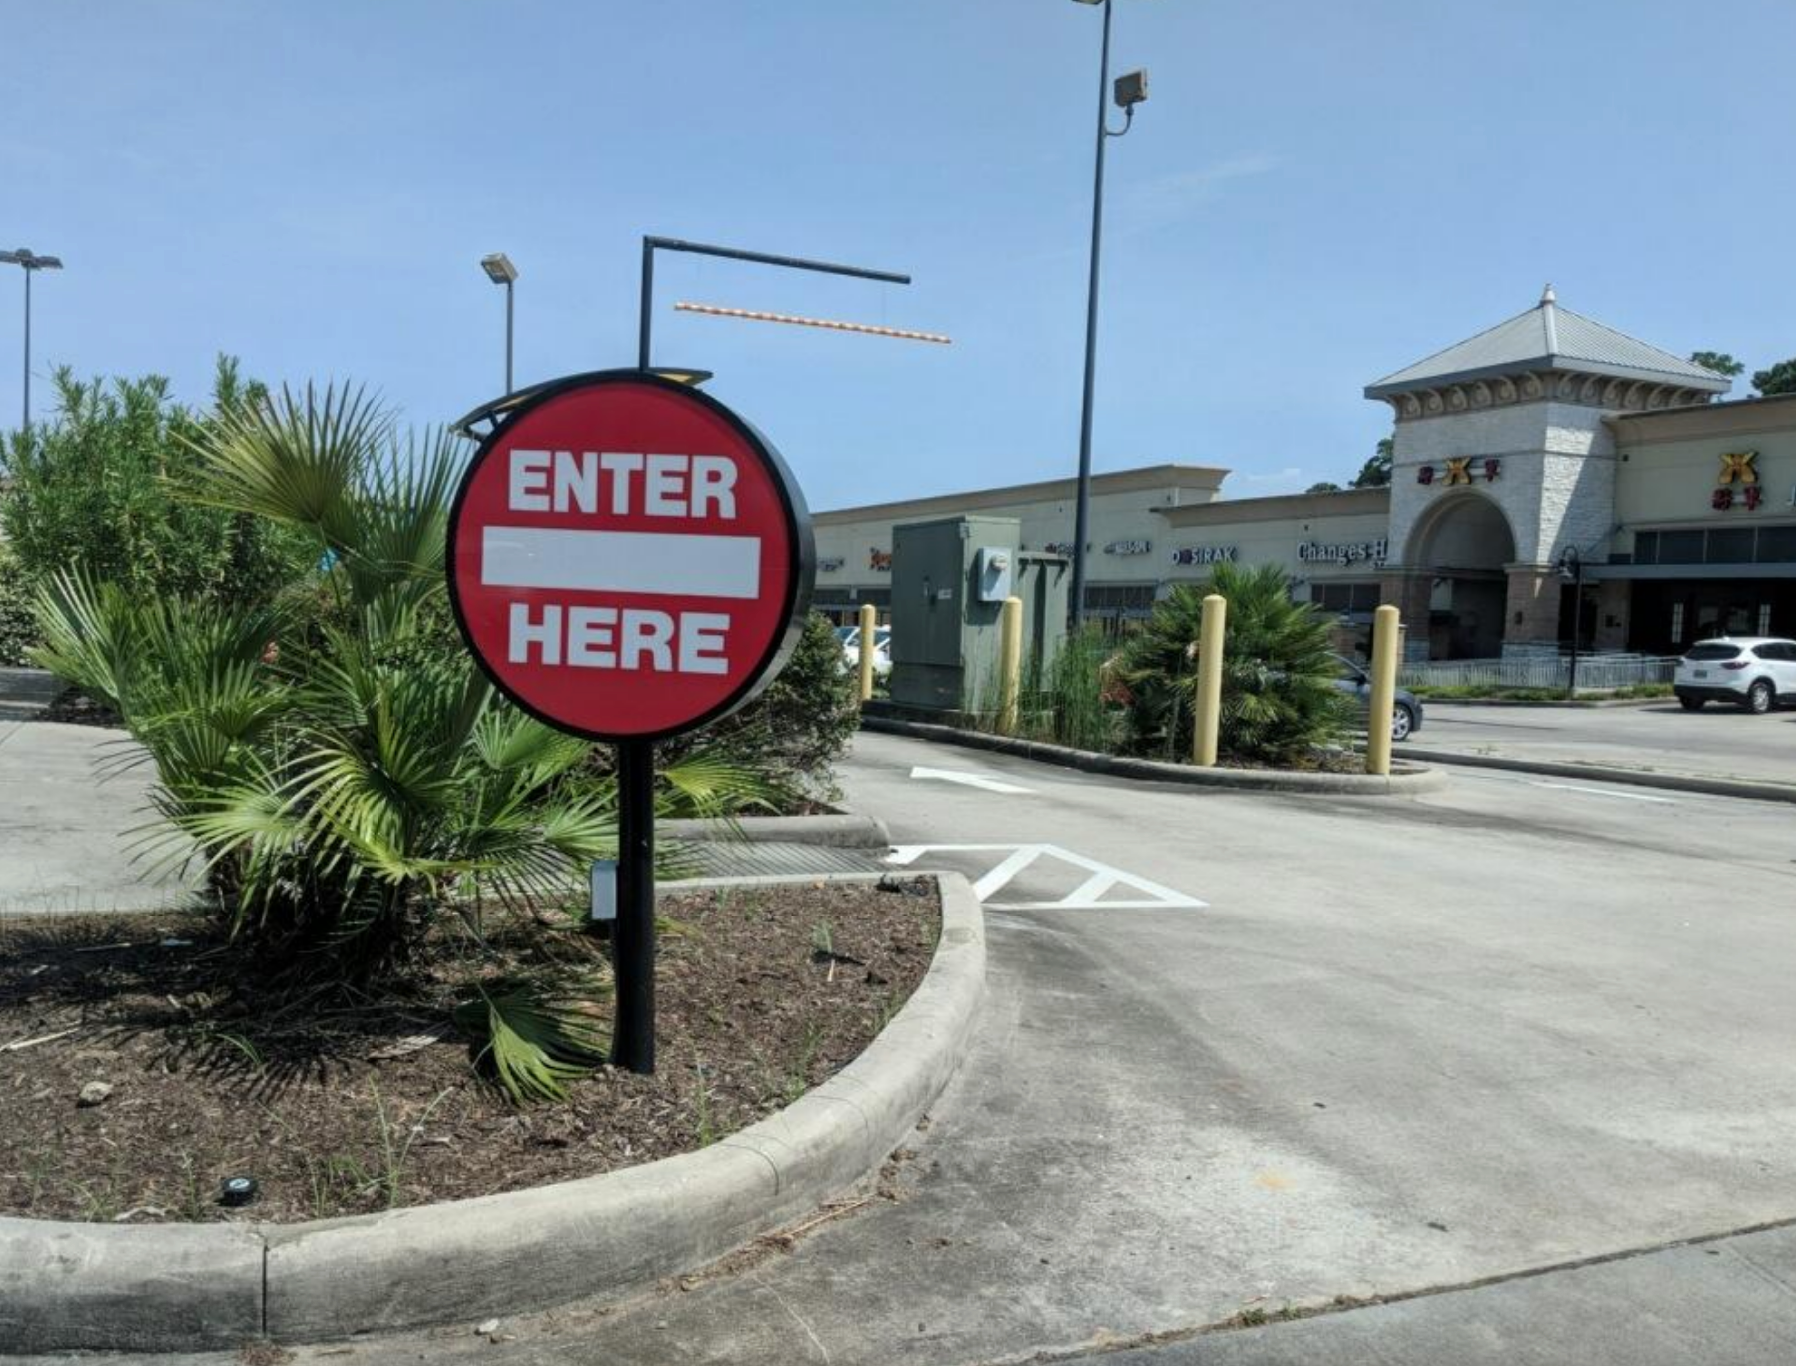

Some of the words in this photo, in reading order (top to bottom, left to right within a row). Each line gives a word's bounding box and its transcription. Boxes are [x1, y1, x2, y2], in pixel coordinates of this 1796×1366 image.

[509, 449, 737, 519] ENTER
[1297, 540, 1367, 566] Changes
[508, 604, 730, 674] HERE
